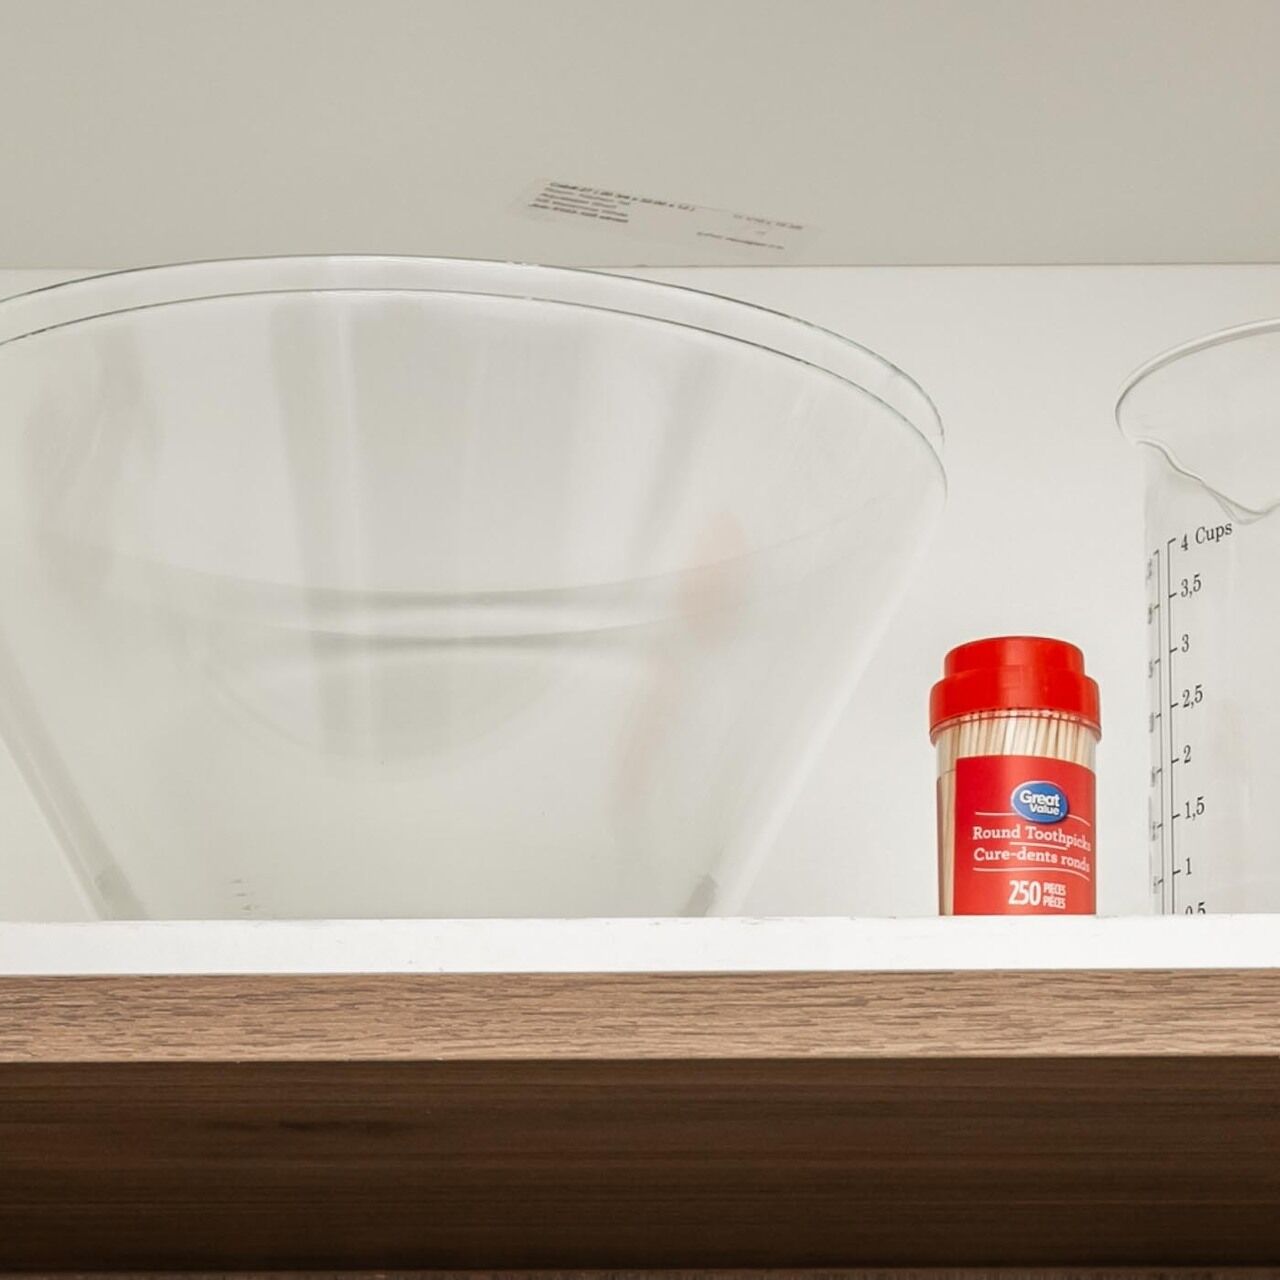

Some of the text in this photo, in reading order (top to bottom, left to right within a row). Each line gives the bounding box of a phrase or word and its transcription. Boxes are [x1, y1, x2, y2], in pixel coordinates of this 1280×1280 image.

[1180, 522, 1233, 552] 4 Cups
[1180, 573, 1202, 598] 3,5
[1180, 633, 1190, 653] 3
[1181, 684, 1204, 709] 2,5
[1183, 744, 1192, 764] 2
[1019, 789, 1061, 807] Great
[1029, 803, 1061, 817] Value
[1184, 796, 1205, 821] 1,5
[972, 824, 1092, 852] Round Toothpicks
[973, 846, 1091, 873] Cure-dents ronds
[1186, 857, 1193, 876] 1
[1008, 880, 1042, 906] 250
